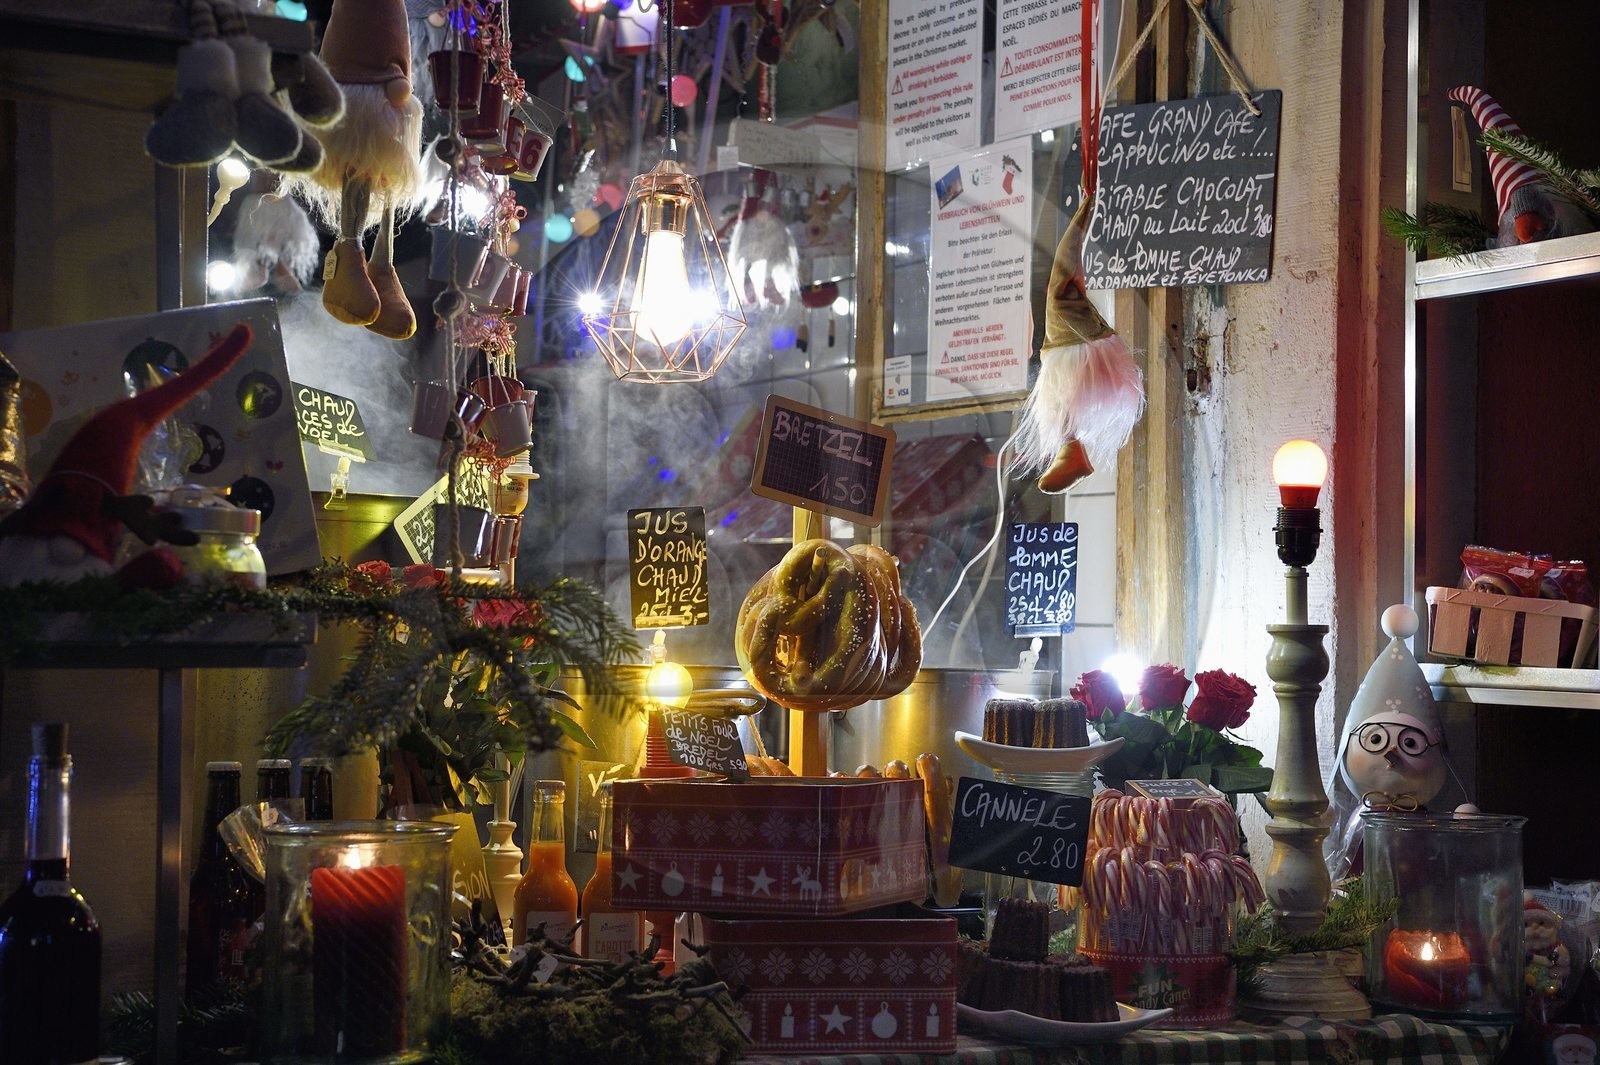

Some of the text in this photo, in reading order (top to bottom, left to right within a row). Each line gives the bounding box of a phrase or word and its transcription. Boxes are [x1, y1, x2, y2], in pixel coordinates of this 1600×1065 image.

[1062, 2, 1082, 15] MARCH
[1149, 100, 1211, 146] GRAND
[1177, 173, 1275, 206] CHOCOLAT
[937, 206, 968, 220] VERBRAUCH
[1090, 212, 1140, 250] CHAUD
[1086, 241, 1241, 275] US de POMME CHAUD
[1085, 273, 1158, 290] ARDAMONE
[1161, 275, 1177, 287] et
[898, 388, 909, 396] VISA
[298, 388, 355, 426] CHAUD
[337, 418, 364, 436] de
[634, 510, 688, 535] JUS
[1053, 523, 1078, 544] de
[635, 533, 708, 565] D'ORANGE
[1008, 546, 1077, 568] POMME
[638, 564, 702, 593] CHAUD
[1008, 569, 1071, 601] CHAUD
[666, 724, 688, 741] de
